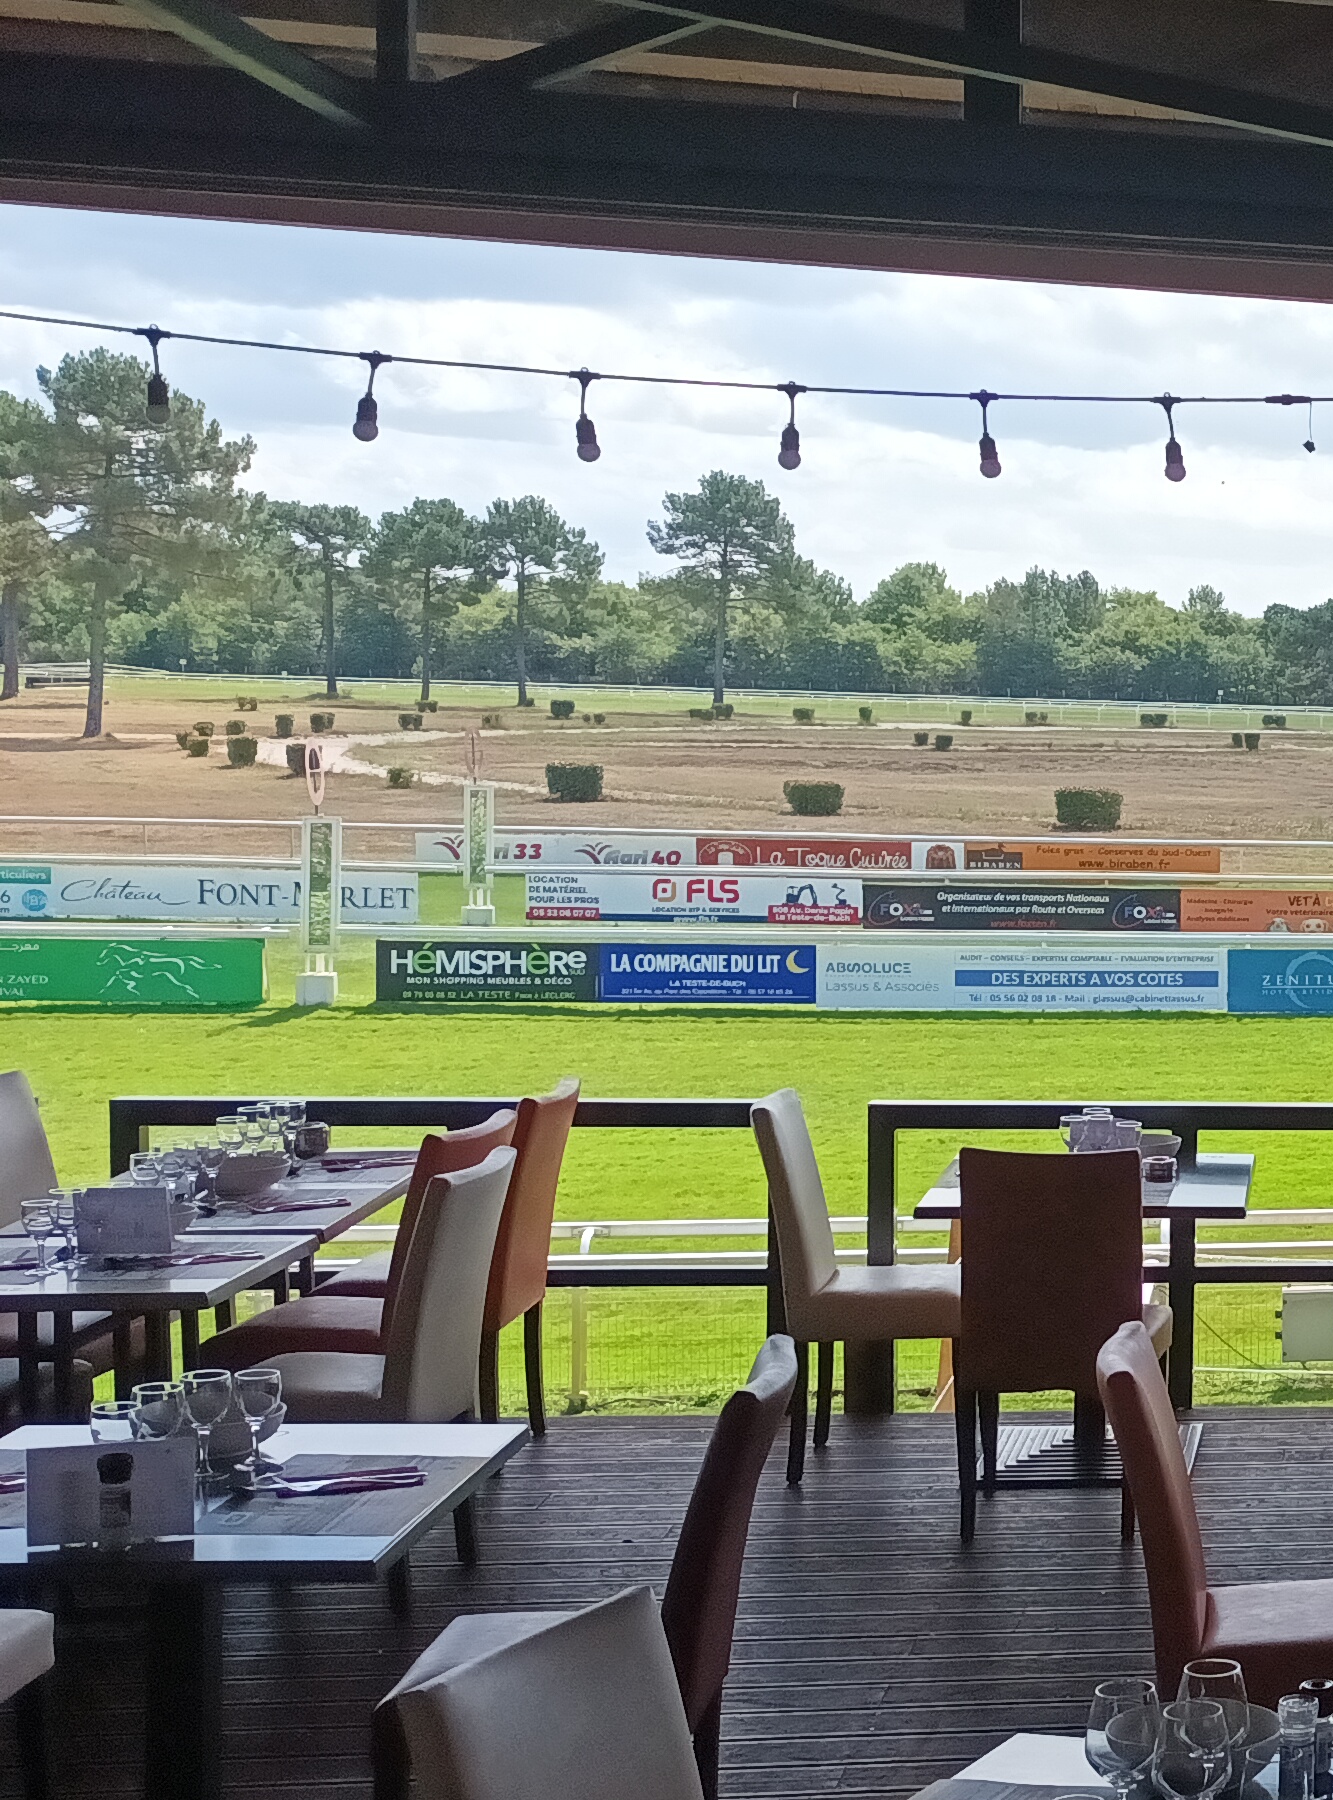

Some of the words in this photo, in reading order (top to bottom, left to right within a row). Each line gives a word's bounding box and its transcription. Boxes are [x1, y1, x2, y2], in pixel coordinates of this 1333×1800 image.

[513, 843, 543, 860] 33
[1097, 847, 1144, 856] Conserves
[1147, 848, 1159, 856] du
[1161, 848, 1212, 857] Sud-Ouest
[651, 850, 682, 865] 40
[754, 846, 786, 865] La
[786, 848, 847, 868] Toque
[849, 848, 909, 869] Cuivrée
[969, 861, 1021, 870] BIRABEN
[1078, 859, 1171, 869] www.biraben.fr
[528, 875, 579, 884] LOCATION
[61, 877, 191, 906] Château
[528, 885, 542, 893] DE
[543, 885, 588, 893] MATÉRIEL
[686, 879, 740, 903] FLS
[528, 895, 556, 904] POUR
[556, 896, 573, 904] LES
[574, 896, 600, 904] PROS
[936, 892, 992, 902] Organisateur
[993, 892, 1005, 901] de
[1006, 893, 1021, 901] vos
[1022, 893, 1065, 903] transports
[1066, 893, 1110, 903] Nationaux
[941, 905, 951, 913] et
[951, 904, 1014, 913] Internationaux
[1015, 906, 1031, 915] par
[1031, 906, 1057, 914] Route
[1057, 906, 1066, 914] et
[1066, 906, 1105, 915] Overseas
[610, 953, 631, 973] LA
[633, 954, 729, 973] COMPAGNIE
[730, 954, 754, 973] DU
[757, 954, 781, 973] LIT
[960, 954, 983, 962] AUDIT
[825, 962, 912, 974] ABSOLUCE
[6, 974, 49, 985] ZAYED
[406, 977, 431, 985] MON
[432, 977, 485, 985] SHOPPING
[486, 977, 532, 985] MEUBLES
[543, 975, 573, 985] DÉCO
[991, 973, 1020, 985] DES
[1023, 973, 1086, 985] EXPERTS
[1090, 973, 1101, 985] A
[1104, 973, 1135, 985] VOS
[1137, 973, 1184, 986] COTES
[825, 981, 870, 992] Lassus
[872, 981, 882, 992] &
[884, 980, 940, 992] Associés
[460, 991, 475, 999] LA
[478, 991, 511, 999] TESTE
[989, 994, 1002, 1002] 05
[1004, 994, 1016, 1002] 56
[1017, 994, 1029, 1002] 02
[1064, 994, 1085, 1003] Mail
